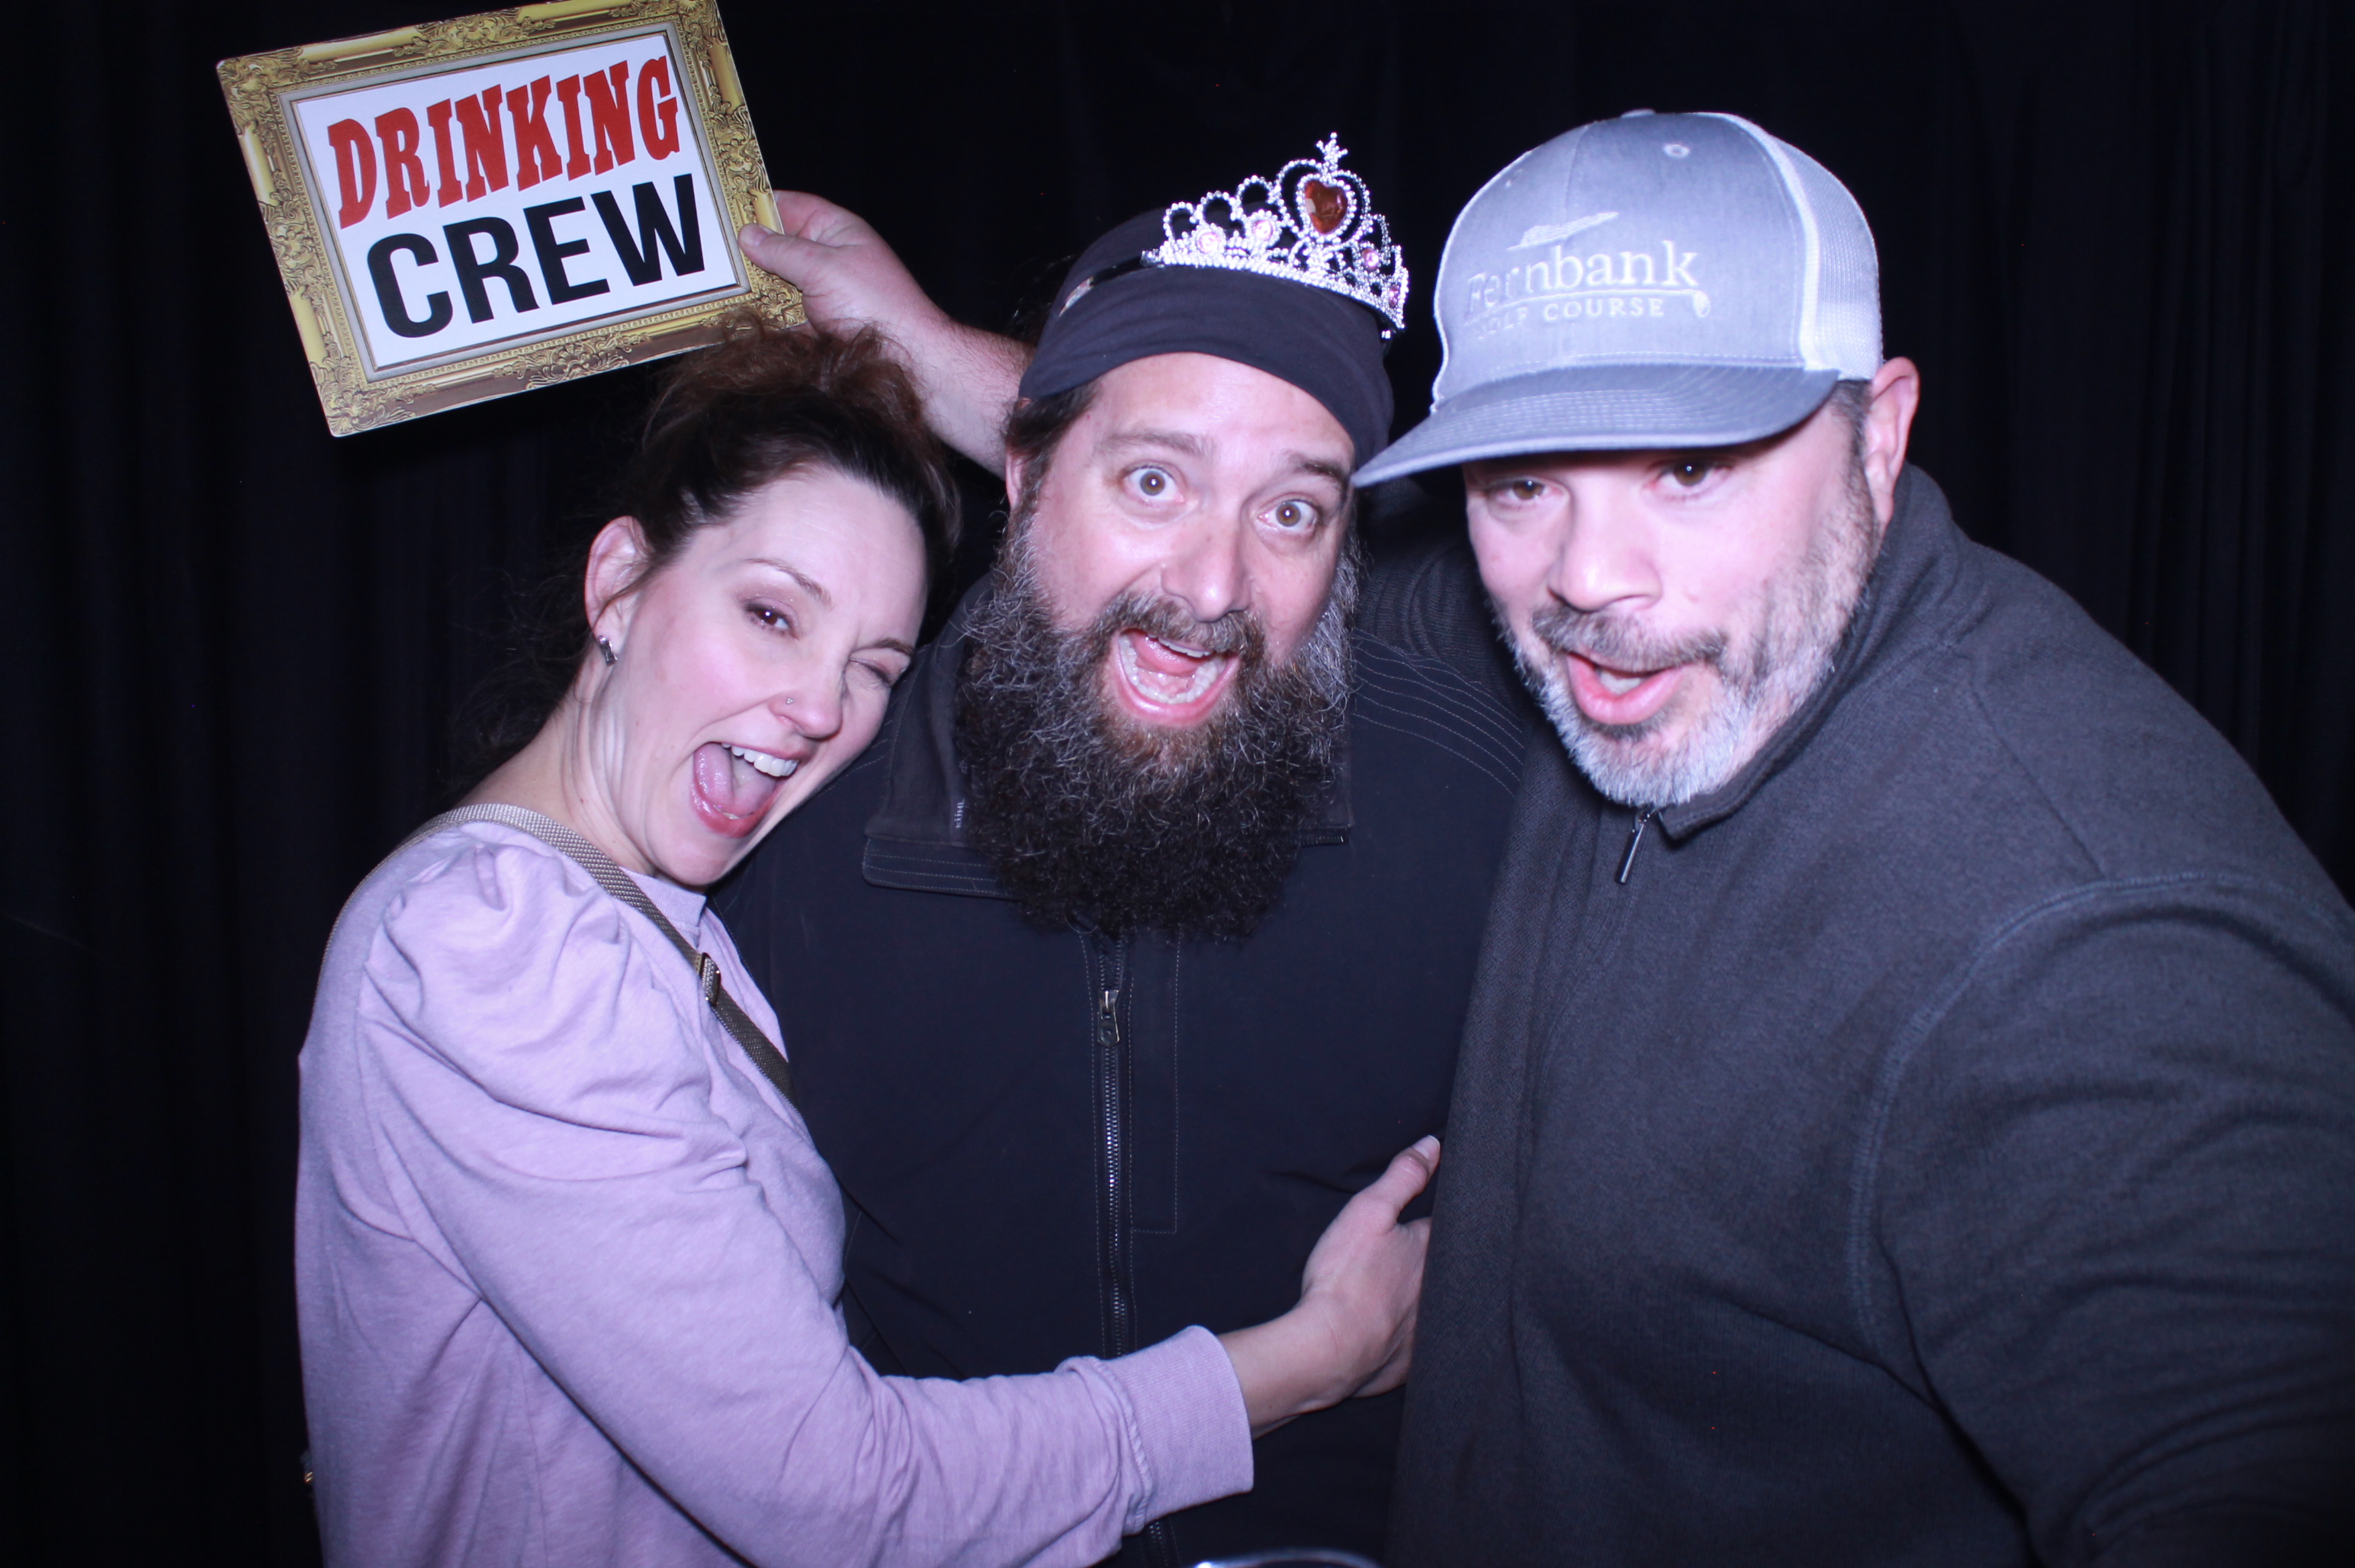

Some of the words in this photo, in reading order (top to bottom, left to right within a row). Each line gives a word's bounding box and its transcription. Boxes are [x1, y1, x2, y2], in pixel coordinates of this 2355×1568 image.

[327, 55, 681, 230] DRINKING
[366, 173, 705, 338] CREW
[1467, 239, 1700, 313] Fernbank
[1542, 296, 1666, 322] COURSE
